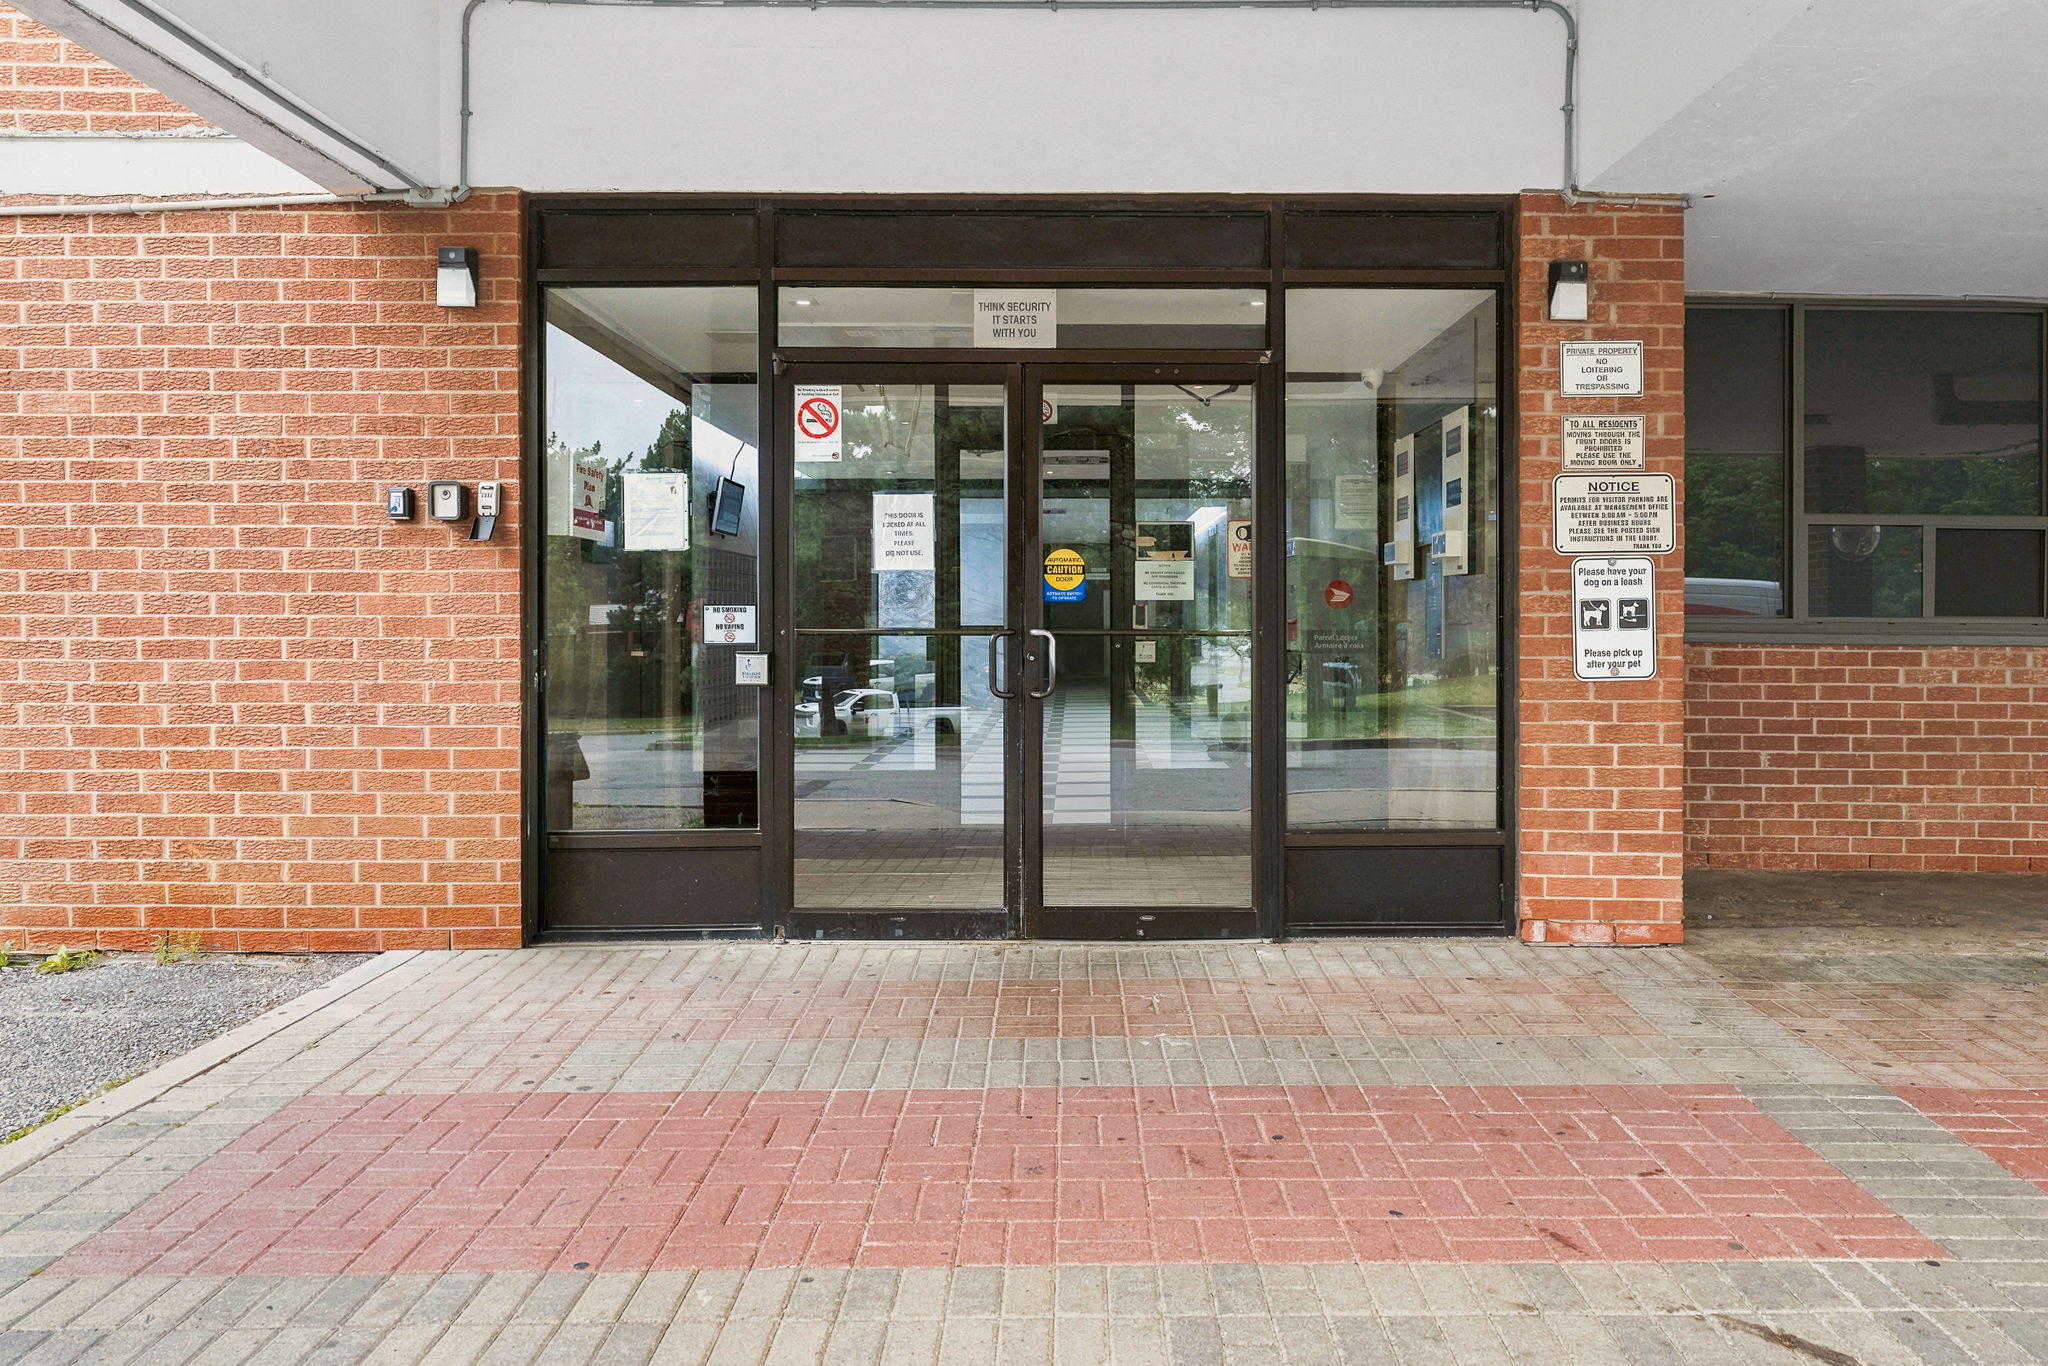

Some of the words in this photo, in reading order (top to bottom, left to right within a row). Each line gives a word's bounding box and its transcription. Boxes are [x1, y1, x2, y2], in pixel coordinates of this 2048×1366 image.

[978, 302, 1005, 312] THINK
[1007, 302, 1051, 312] SECURITY
[993, 315, 1001, 325] IT
[1003, 315, 1037, 325] STARTS
[993, 328, 1015, 338] WITH
[1018, 328, 1037, 338] YOU
[1598, 347, 1638, 355] PROPERTY
[1575, 383, 1630, 391] TRESPASSING
[1570, 420, 1579, 429] TO
[1582, 420, 1595, 428] ALL
[1598, 420, 1638, 428] RESIDENTS
[1588, 482, 1640, 492] NOTICE
[1046, 565, 1083, 574] CAUTION
[1578, 568, 1605, 576] Please
[1607, 567, 1626, 576] have
[1628, 568, 1647, 577] your
[1583, 579, 1599, 588] dog
[1620, 577, 1643, 586] leash
[1584, 649, 1611, 658] Please
[1613, 649, 1631, 658] pick
[1632, 649, 1643, 658] up
[1586, 660, 1605, 668] after
[1607, 660, 1626, 669] your
[1627, 659, 1641, 669] pet
